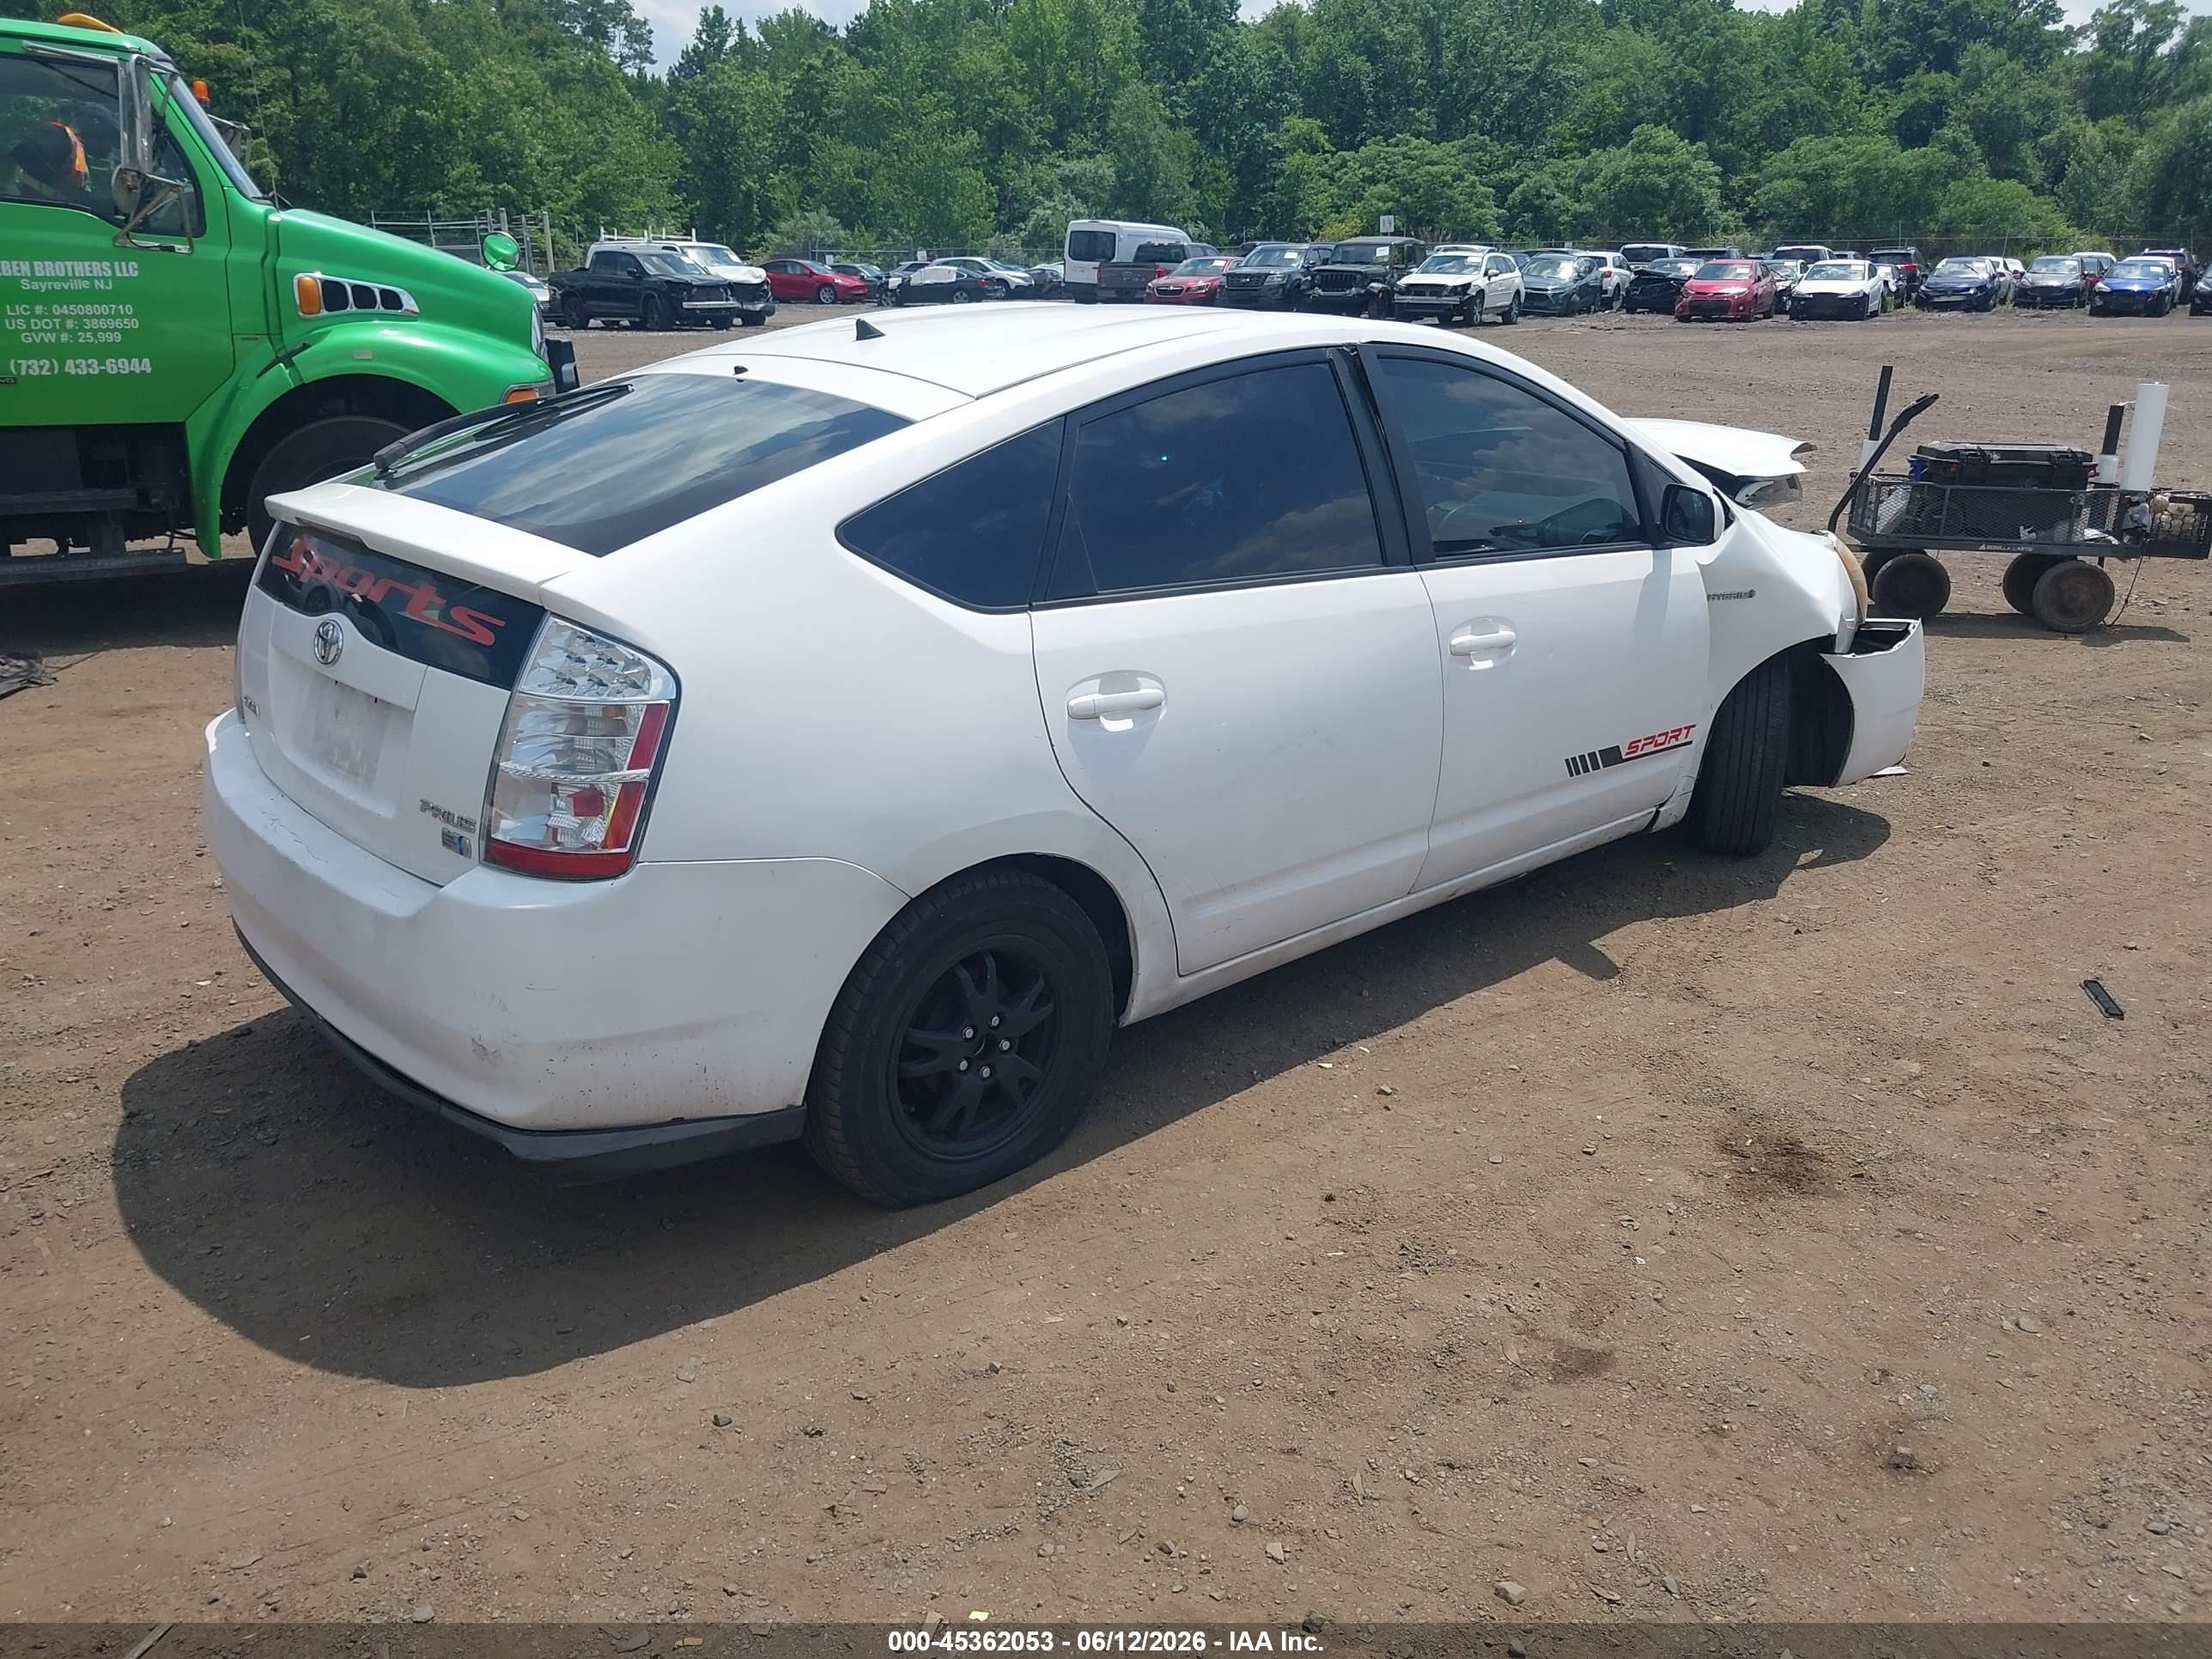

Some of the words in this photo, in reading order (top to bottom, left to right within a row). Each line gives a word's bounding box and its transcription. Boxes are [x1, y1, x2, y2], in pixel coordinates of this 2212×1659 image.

[0, 261, 31, 276] BEN
[33, 261, 112, 276] BROTHERS
[114, 262, 138, 276] LLC
[21, 279, 89, 292] Sayreville
[94, 279, 112, 289] NJ
[6, 305, 30, 315] LIC
[34, 305, 48, 315] #:
[52, 305, 133, 315] 0450800710
[5, 319, 27, 330] US
[31, 319, 61, 330] DOT
[65, 319, 78, 329] #:
[82, 319, 138, 329] 3869650
[21, 332, 56, 343] GVW
[60, 332, 73, 343] #:
[77, 331, 122, 343] 25,999
[9, 359, 59, 375] (732)
[64, 358, 152, 374] 433-6944
[1624, 724, 1697, 756] SPORT
[420, 798, 477, 834] PRIUS
